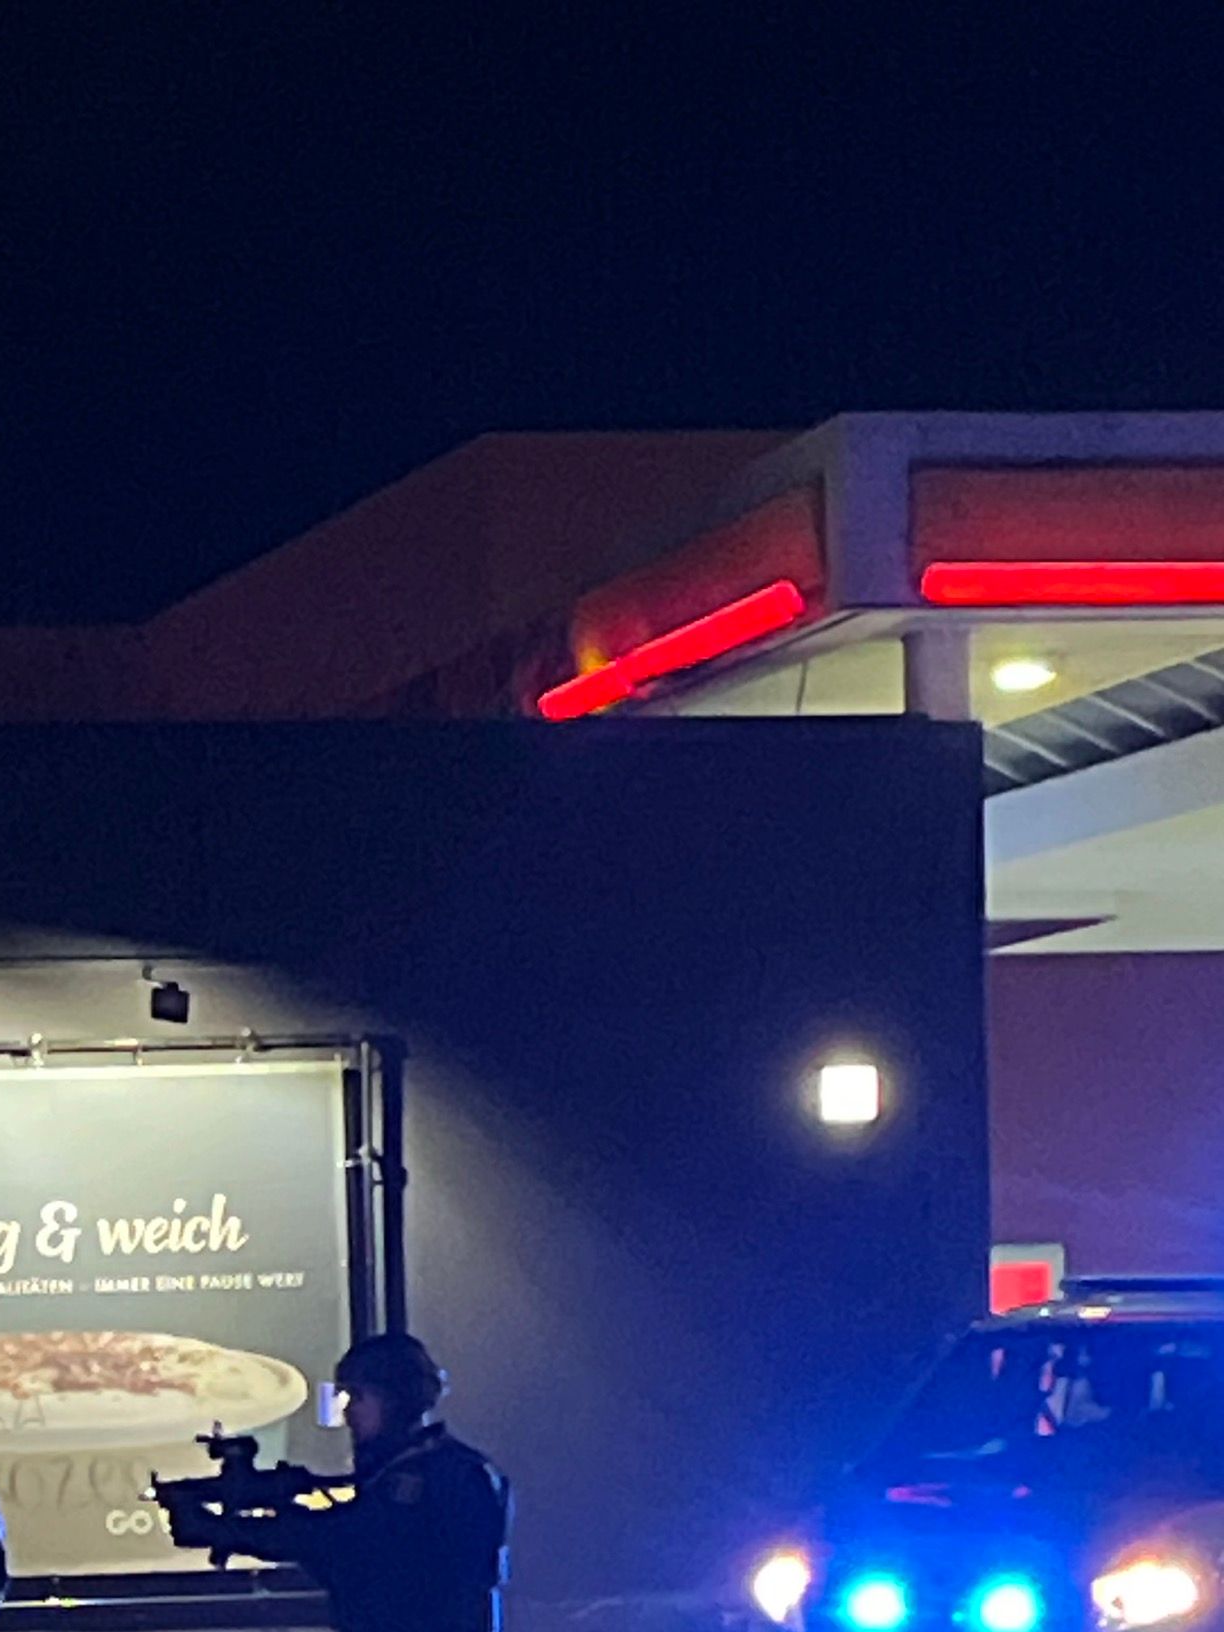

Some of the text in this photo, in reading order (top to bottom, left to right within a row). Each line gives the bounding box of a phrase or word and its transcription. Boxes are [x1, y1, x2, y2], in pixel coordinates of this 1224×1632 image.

[35, 1200, 82, 1263] &
[96, 1193, 250, 1256] weich
[93, 1275, 151, 1293] IMMER
[155, 1274, 195, 1292] EINE
[200, 1271, 253, 1290] PAUSE
[257, 1270, 305, 1288] WERT
[105, 1509, 154, 1535] GO
